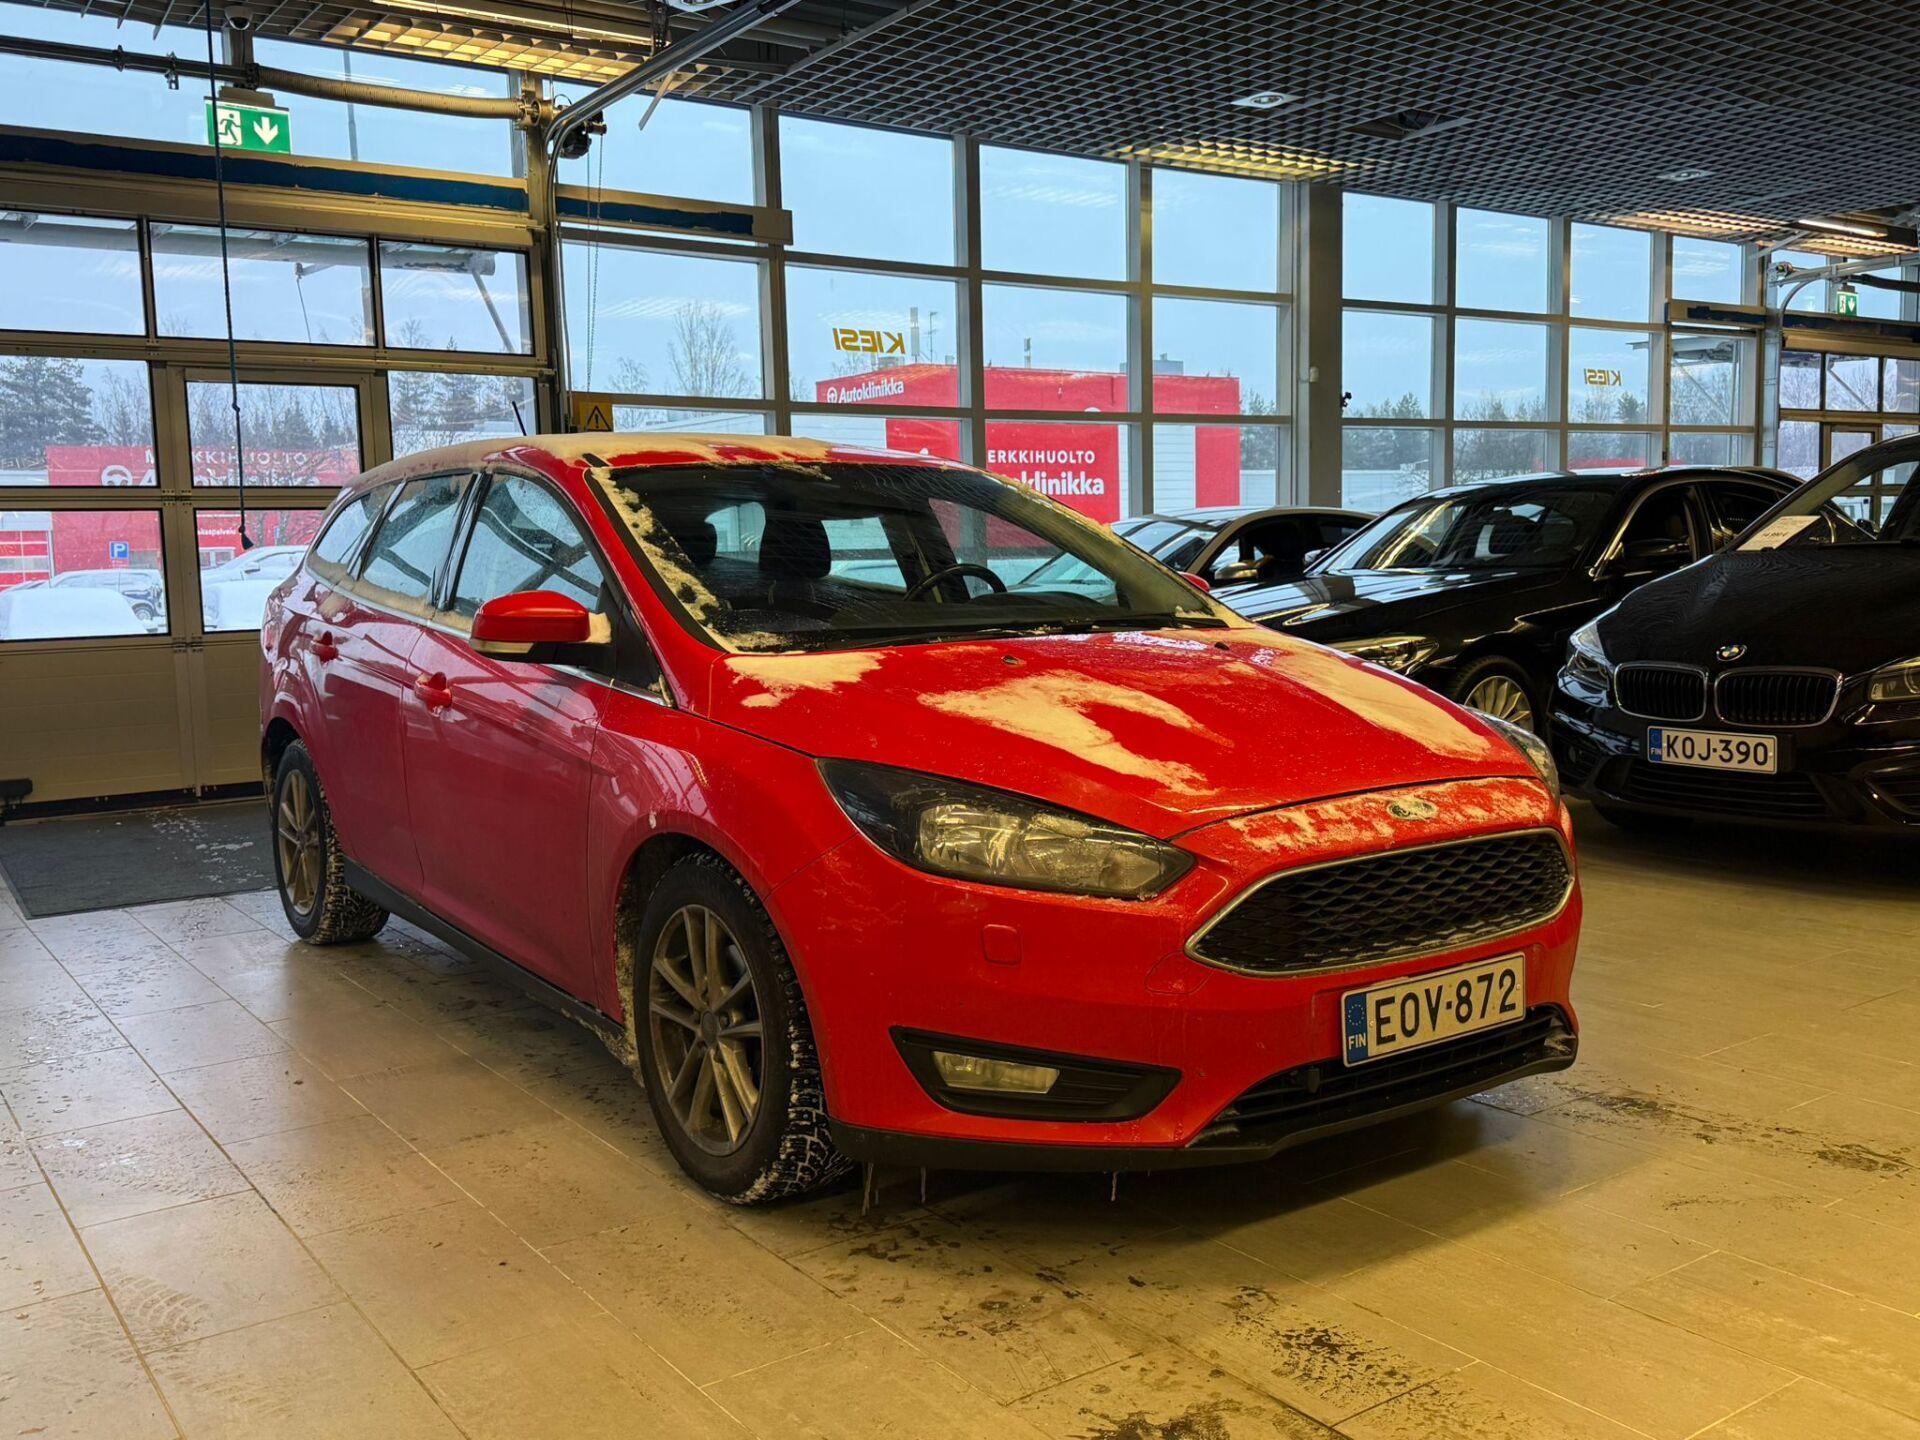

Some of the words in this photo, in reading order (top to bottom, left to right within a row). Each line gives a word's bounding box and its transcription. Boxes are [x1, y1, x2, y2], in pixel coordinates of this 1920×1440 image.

[839, 377, 905, 404] Autoklinikka
[987, 449, 1096, 464] ERKKIHUOLTO
[1012, 471, 1105, 495] klinikka
[113, 543, 126, 558] P
[1666, 734, 1768, 766] KOJ-390
[1375, 968, 1516, 1046] EOV-872
[1348, 1033, 1366, 1050] FIN
